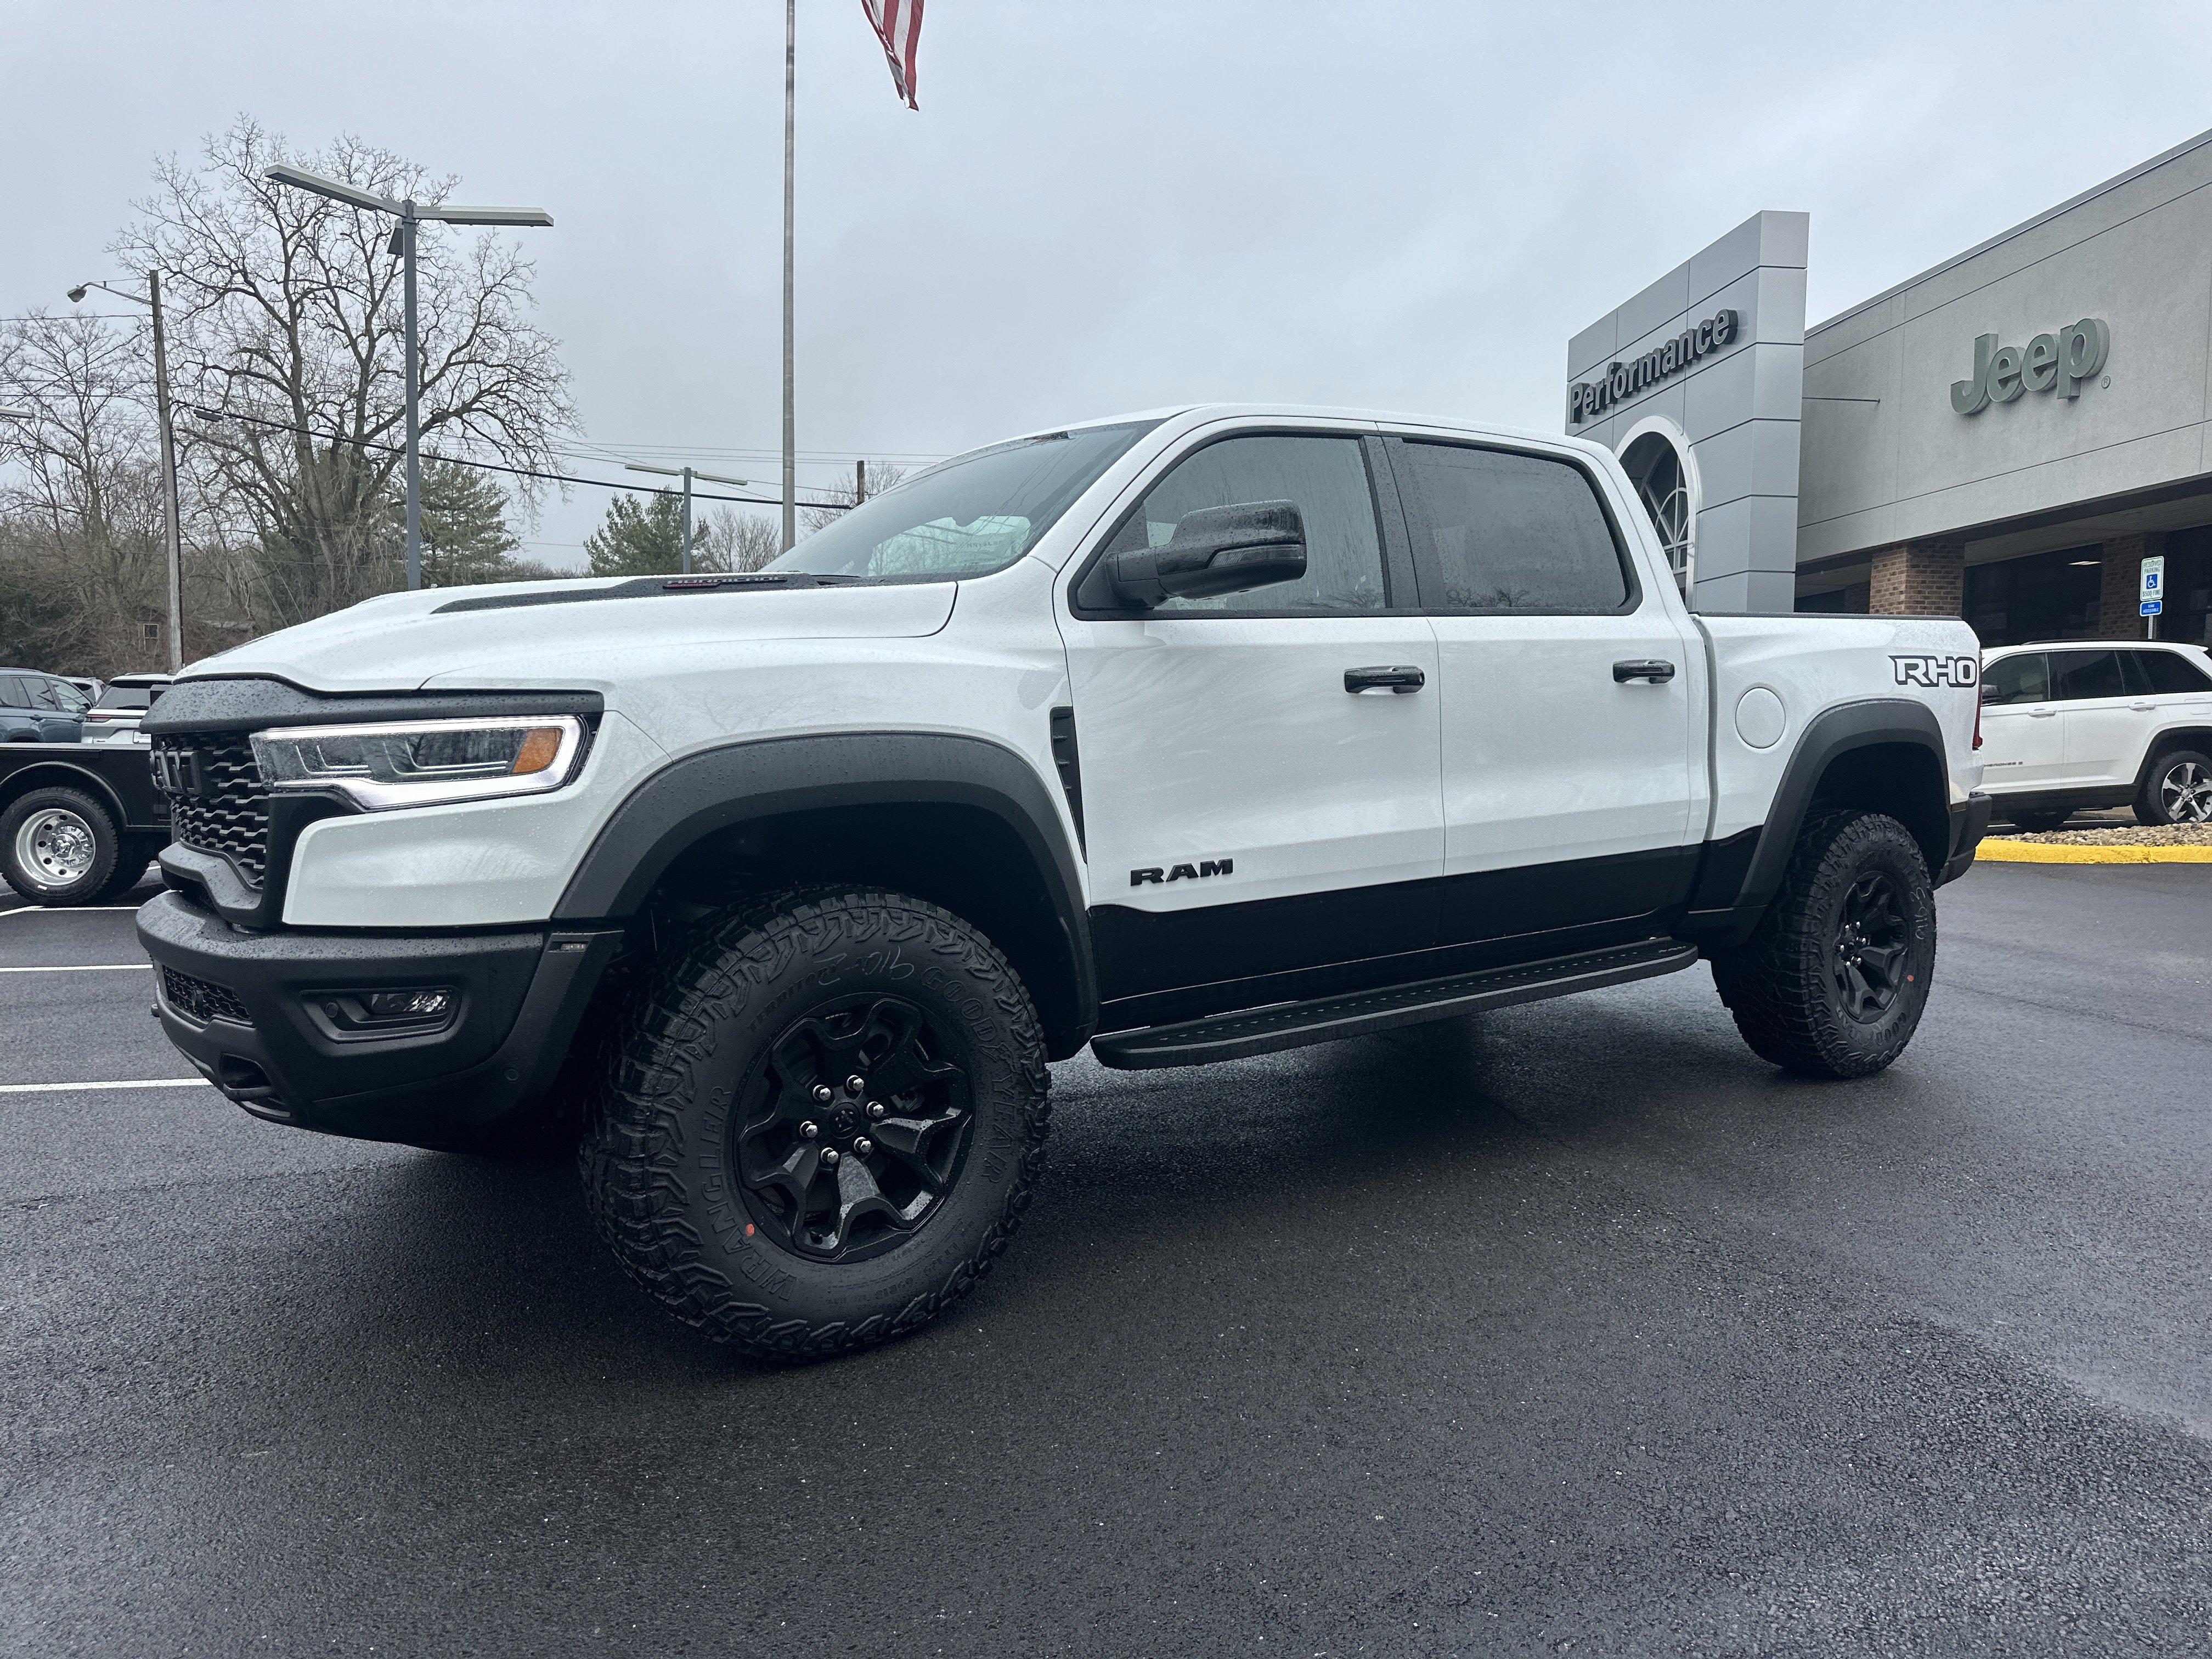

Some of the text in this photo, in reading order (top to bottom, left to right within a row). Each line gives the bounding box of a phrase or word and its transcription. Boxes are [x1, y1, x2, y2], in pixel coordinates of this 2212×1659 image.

[1570, 308, 1738, 424] Performance
[1950, 317, 2110, 414] Jeep
[1887, 655, 1977, 688] RHO
[1131, 859, 1238, 888] RAM
[920, 966, 1017, 1183] GOODYEAR
[700, 1086, 797, 1301] WRANGLER
